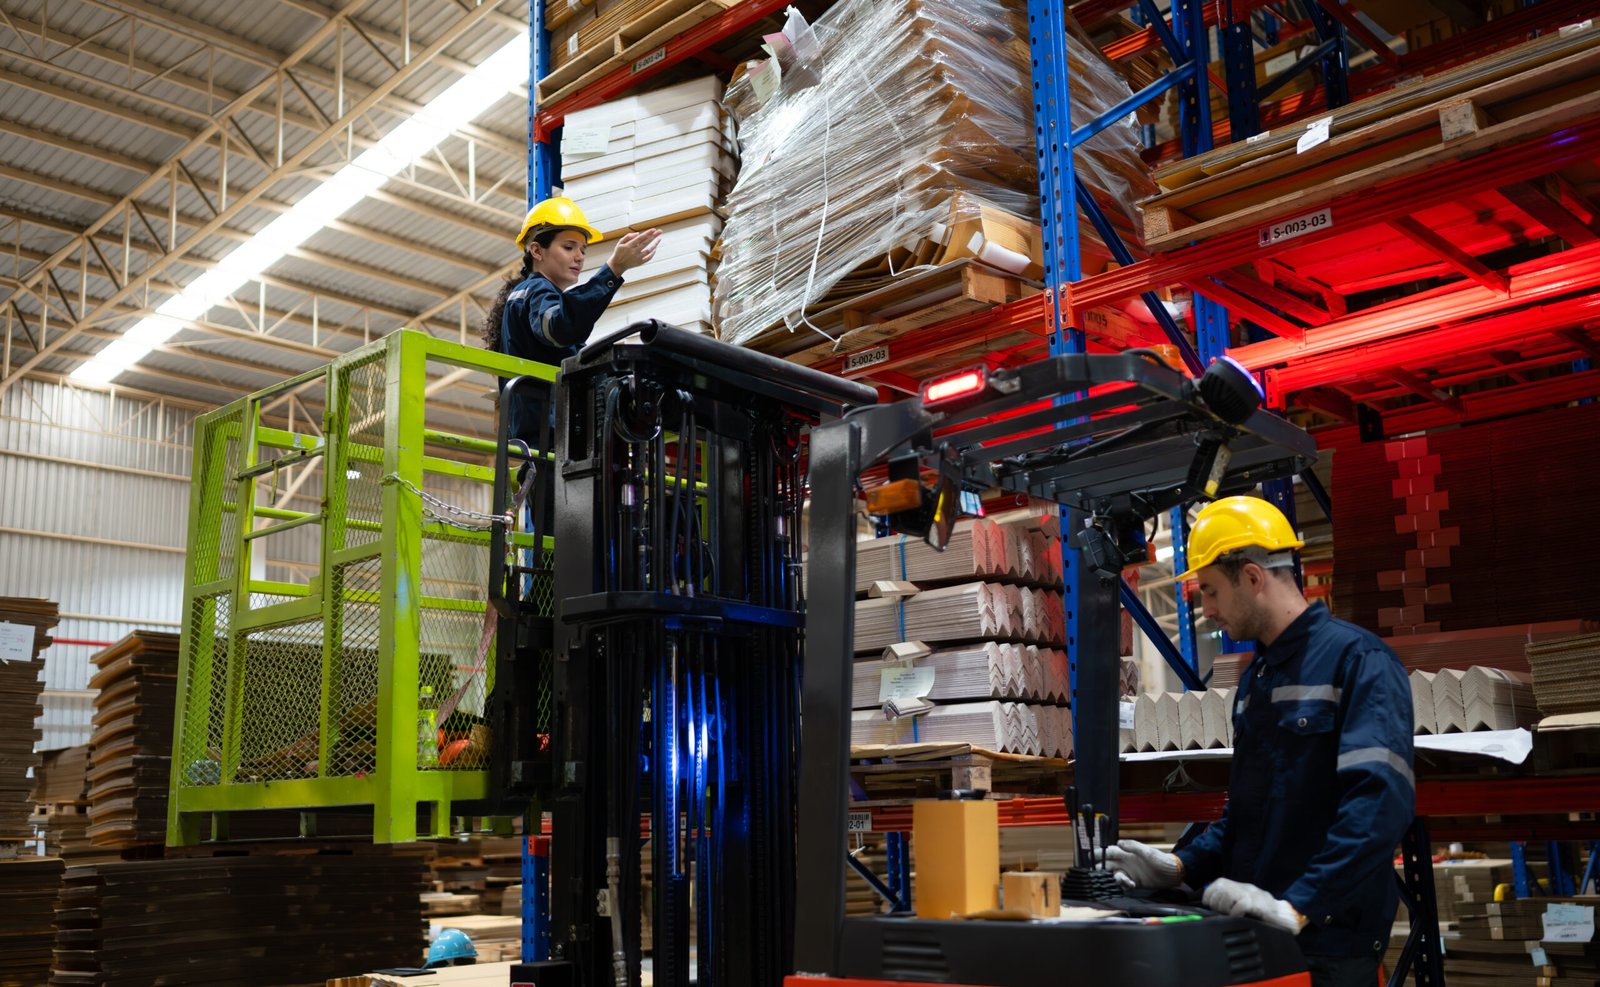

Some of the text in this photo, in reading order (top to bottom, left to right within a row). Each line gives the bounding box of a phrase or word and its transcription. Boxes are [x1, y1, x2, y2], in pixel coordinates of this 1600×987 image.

[637, 50, 663, 70] S-001-04
[1273, 214, 1327, 239] S-003-03
[851, 349, 886, 367] S-002-03
